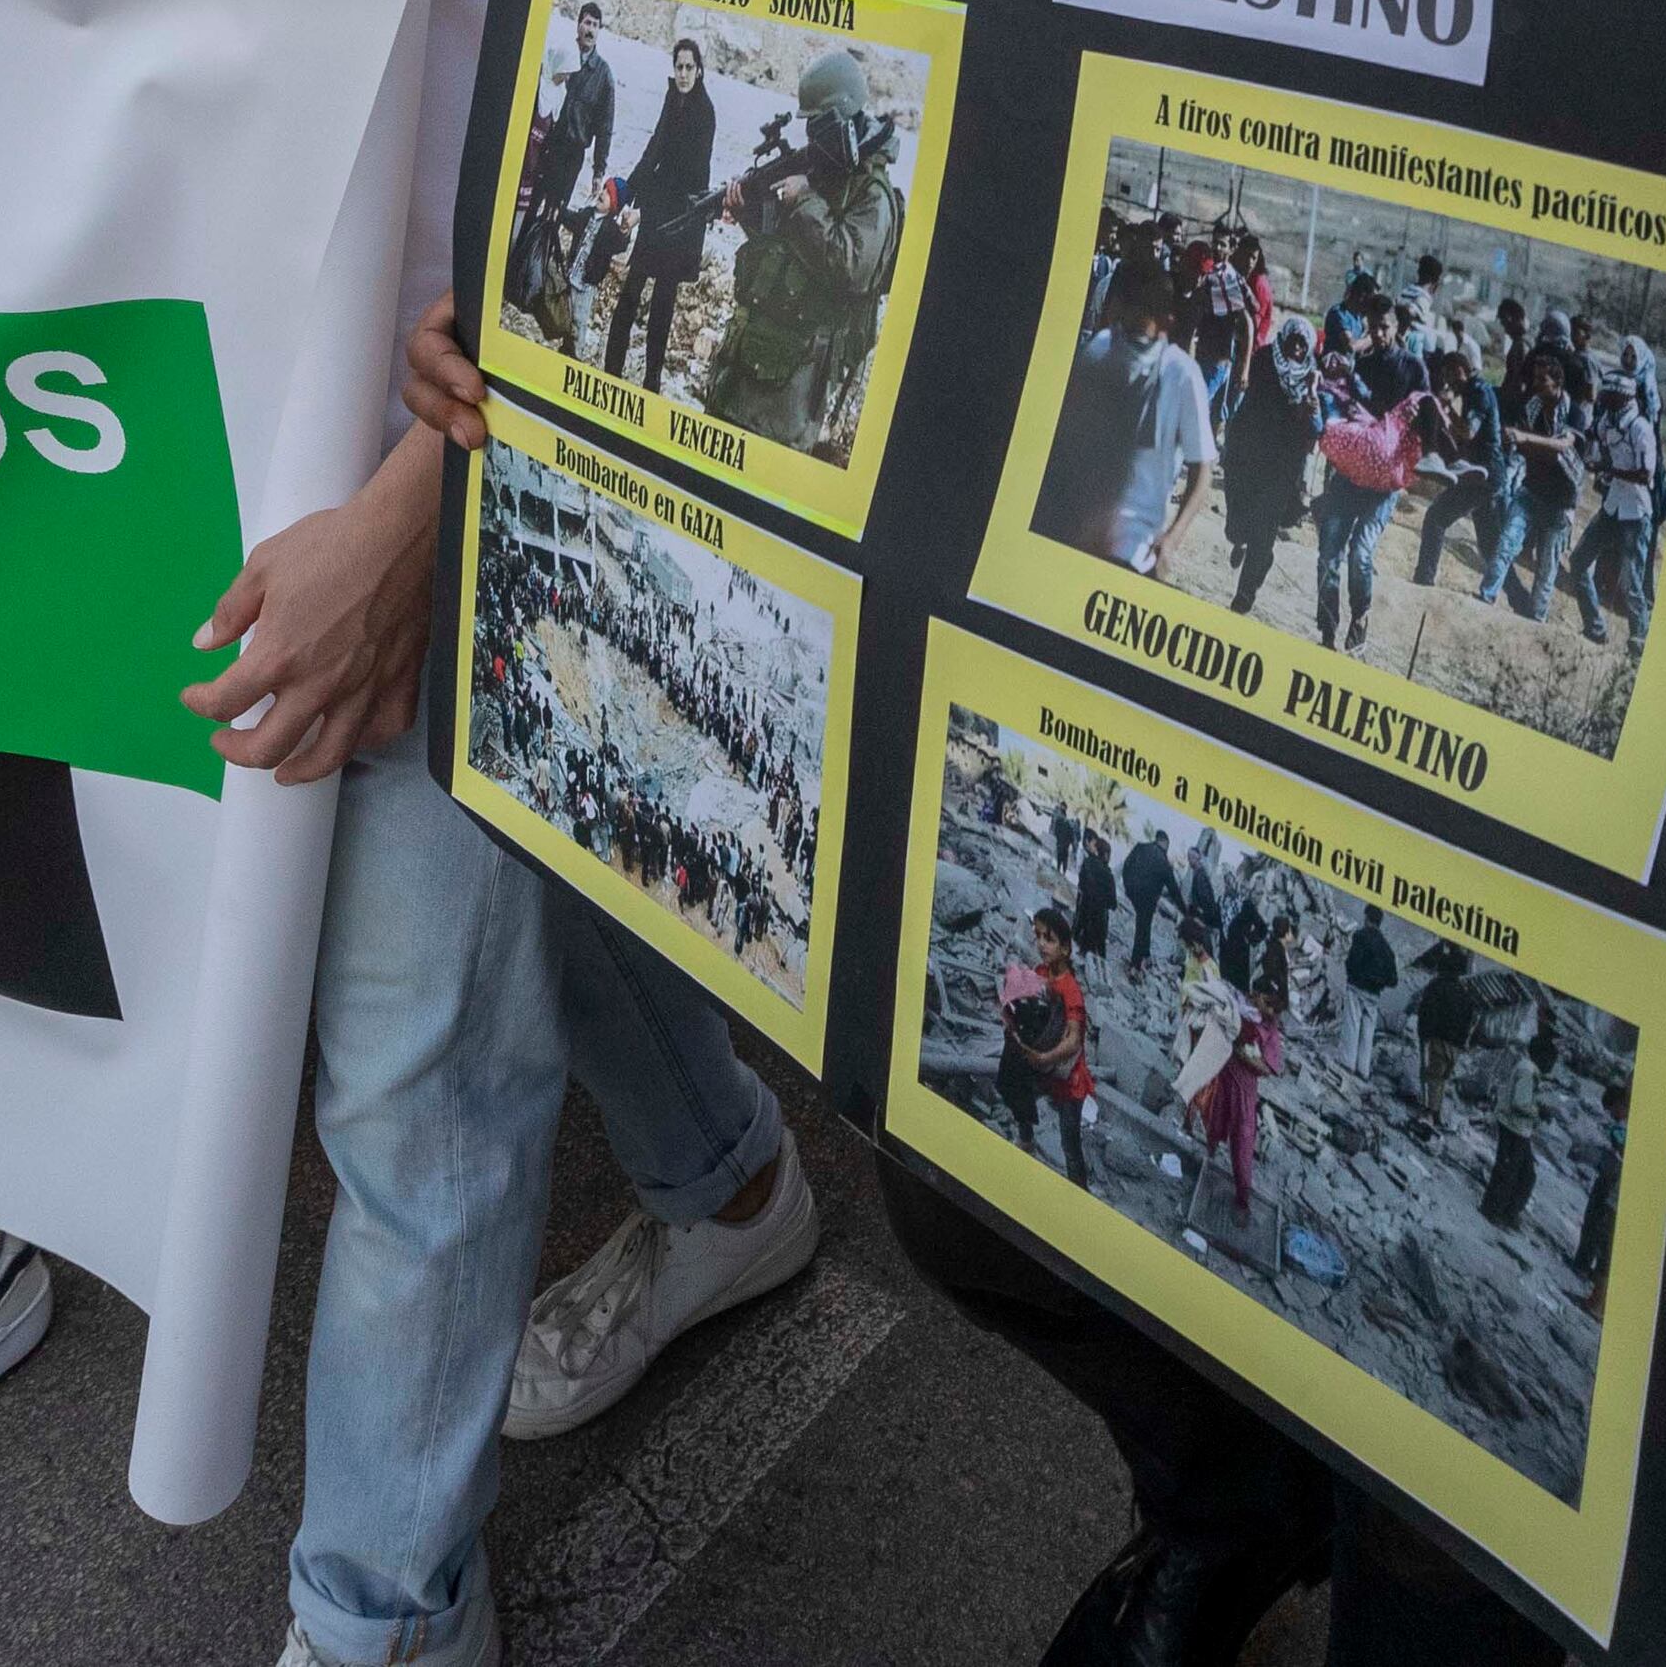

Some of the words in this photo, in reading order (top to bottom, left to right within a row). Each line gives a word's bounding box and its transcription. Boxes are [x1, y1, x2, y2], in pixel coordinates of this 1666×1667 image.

[1154, 95, 1171, 127] A
[1178, 97, 1233, 141] tiros
[1239, 113, 1321, 161] contra
[1328, 132, 1523, 210] manifestantes
[561, 364, 646, 429] PALESTINA
[668, 404, 746, 472] VENCERÁ
[553, 436, 650, 509] Bombardeo
[653, 489, 676, 524] en
[680, 499, 725, 551] GAZA
[1082, 588, 1265, 699] GENOCIDIO
[1282, 669, 1489, 793] PALESTINO
[1038, 705, 1161, 788] Bombardeo
[1173, 777, 1189, 802] a
[1201, 782, 1324, 868] Población
[1329, 832, 1384, 896] civil
[1391, 872, 1521, 959] palestina
